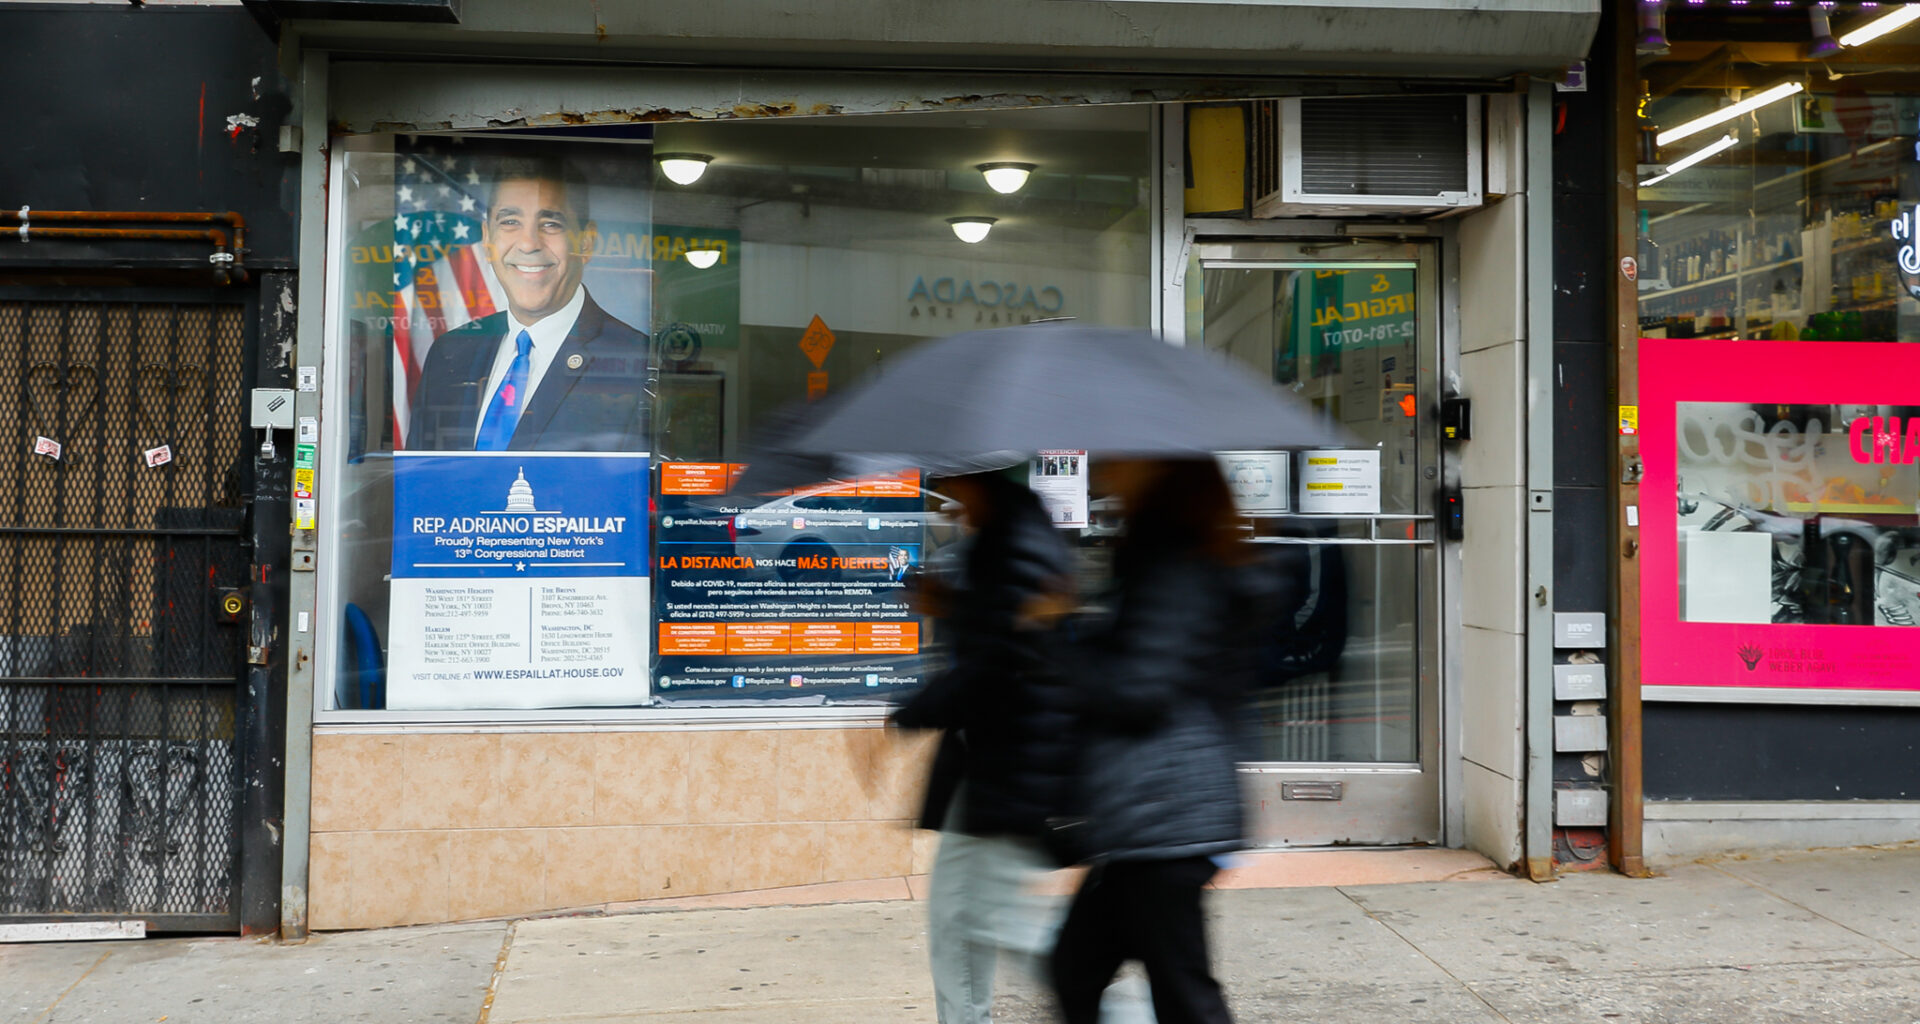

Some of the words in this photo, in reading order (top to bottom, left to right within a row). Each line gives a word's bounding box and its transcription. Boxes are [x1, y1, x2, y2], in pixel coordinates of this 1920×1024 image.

[413, 518, 446, 534] REP.
[450, 518, 530, 534] ADRIANO
[533, 518, 626, 534] ESPAILLAT
[675, 518, 728, 526] espaillat.house.gov
[435, 536, 474, 547] Proudly
[477, 536, 545, 547] Representing
[547, 536, 571, 546] New
[573, 536, 604, 546] York's
[454, 549, 472, 558] 13th
[475, 549, 547, 560] Congressional
[550, 549, 584, 558] District
[660, 557, 678, 569] LA
[681, 557, 754, 569] DISTANCIA
[798, 554, 828, 569] MÁS
[831, 557, 888, 569] FUERTES
[1568, 624, 1592, 632] NYC
[1769, 662, 1802, 672] WEBER
[1807, 662, 1836, 672] AGAVE
[474, 668, 624, 680] WWW.ESPAILLAT.HOUSE.GOV
